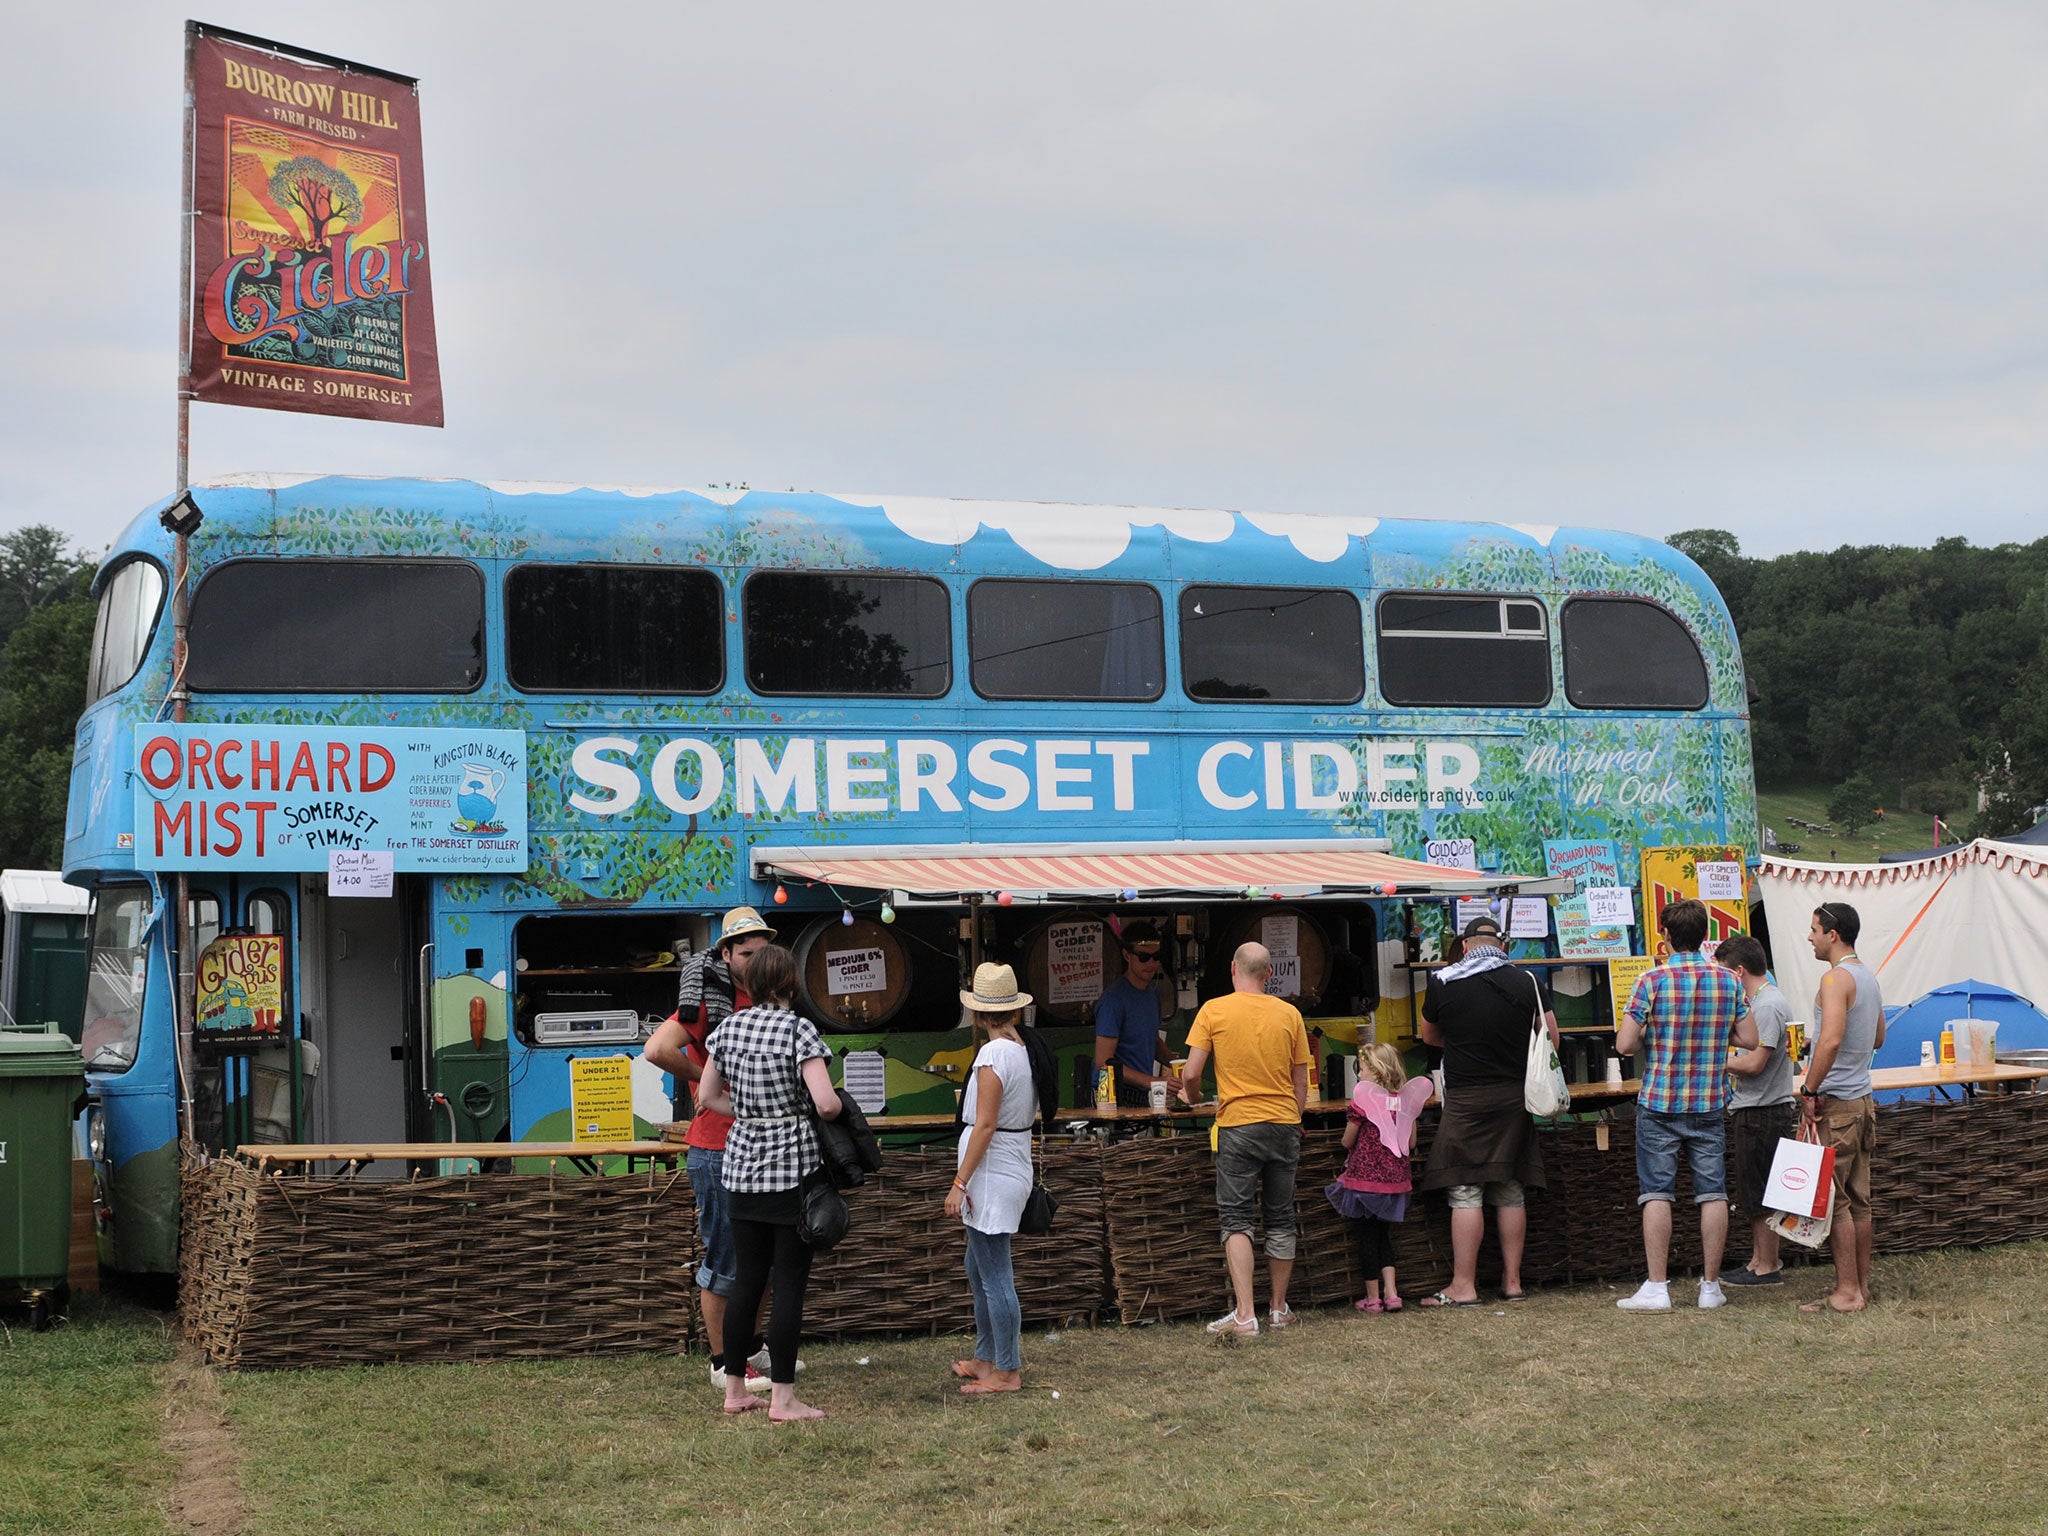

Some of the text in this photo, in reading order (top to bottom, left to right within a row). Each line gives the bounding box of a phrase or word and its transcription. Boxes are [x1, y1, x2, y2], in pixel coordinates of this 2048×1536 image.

[224, 58, 398, 130] BURROW HILL
[273, 107, 357, 141] FARM PRESSED
[232, 219, 324, 254] Somerset
[203, 232, 425, 345] Cider
[354, 316, 399, 332] A BLEND OF
[353, 328, 398, 345] AT LEAST 11
[312, 335, 399, 359] VARIETIES OF VINTAGE
[347, 355, 400, 372] CIDER APPLES
[219, 367, 413, 406] VINTAGE SOMERSET
[407, 743, 431, 752] WITH
[140, 736, 396, 794] ORCHARD
[434, 742, 520, 772] KINGSTON BLACK
[1524, 743, 1660, 774] Matured
[409, 774, 461, 784] APPLE APERITIF
[568, 736, 1485, 815] SOMERSET CIDER
[408, 785, 453, 796] CIDER BRANDY
[1338, 787, 1515, 806] www.ciderbrandy.co.uk
[1575, 771, 1679, 805] in Oak
[409, 799, 452, 808] RASPBERRIES
[283, 801, 379, 833] SOMERSET
[410, 811, 425, 819] AND
[154, 801, 277, 857] MIST
[410, 820, 433, 830] MINT
[278, 833, 292, 845] or
[386, 837, 521, 850] From THE SOMERSET DISTILLERY
[1428, 840, 1472, 858] COLD Cider
[1549, 845, 1608, 863] ORCHARD MIST
[337, 854, 359, 865] Orchard
[1700, 864, 1740, 874] HOT SPICED
[337, 875, 362, 885] £4.00
[1710, 874, 1731, 882] CIDER
[1562, 912, 1582, 920] LEMON
[1654, 881, 1741, 941] HT
[1050, 924, 1102, 939] DRY 6%
[1055, 935, 1096, 948] CIDER
[1584, 946, 1602, 954] SOMERSET
[1604, 946, 1627, 954] DISTILLERY
[199, 938, 279, 993] Cider
[827, 951, 882, 968] MEDIUM 6%
[841, 963, 870, 976] CIDER
[1051, 963, 1077, 975] HOT
[1059, 969, 1101, 986] SPECIALS
[240, 964, 278, 994] Bus
